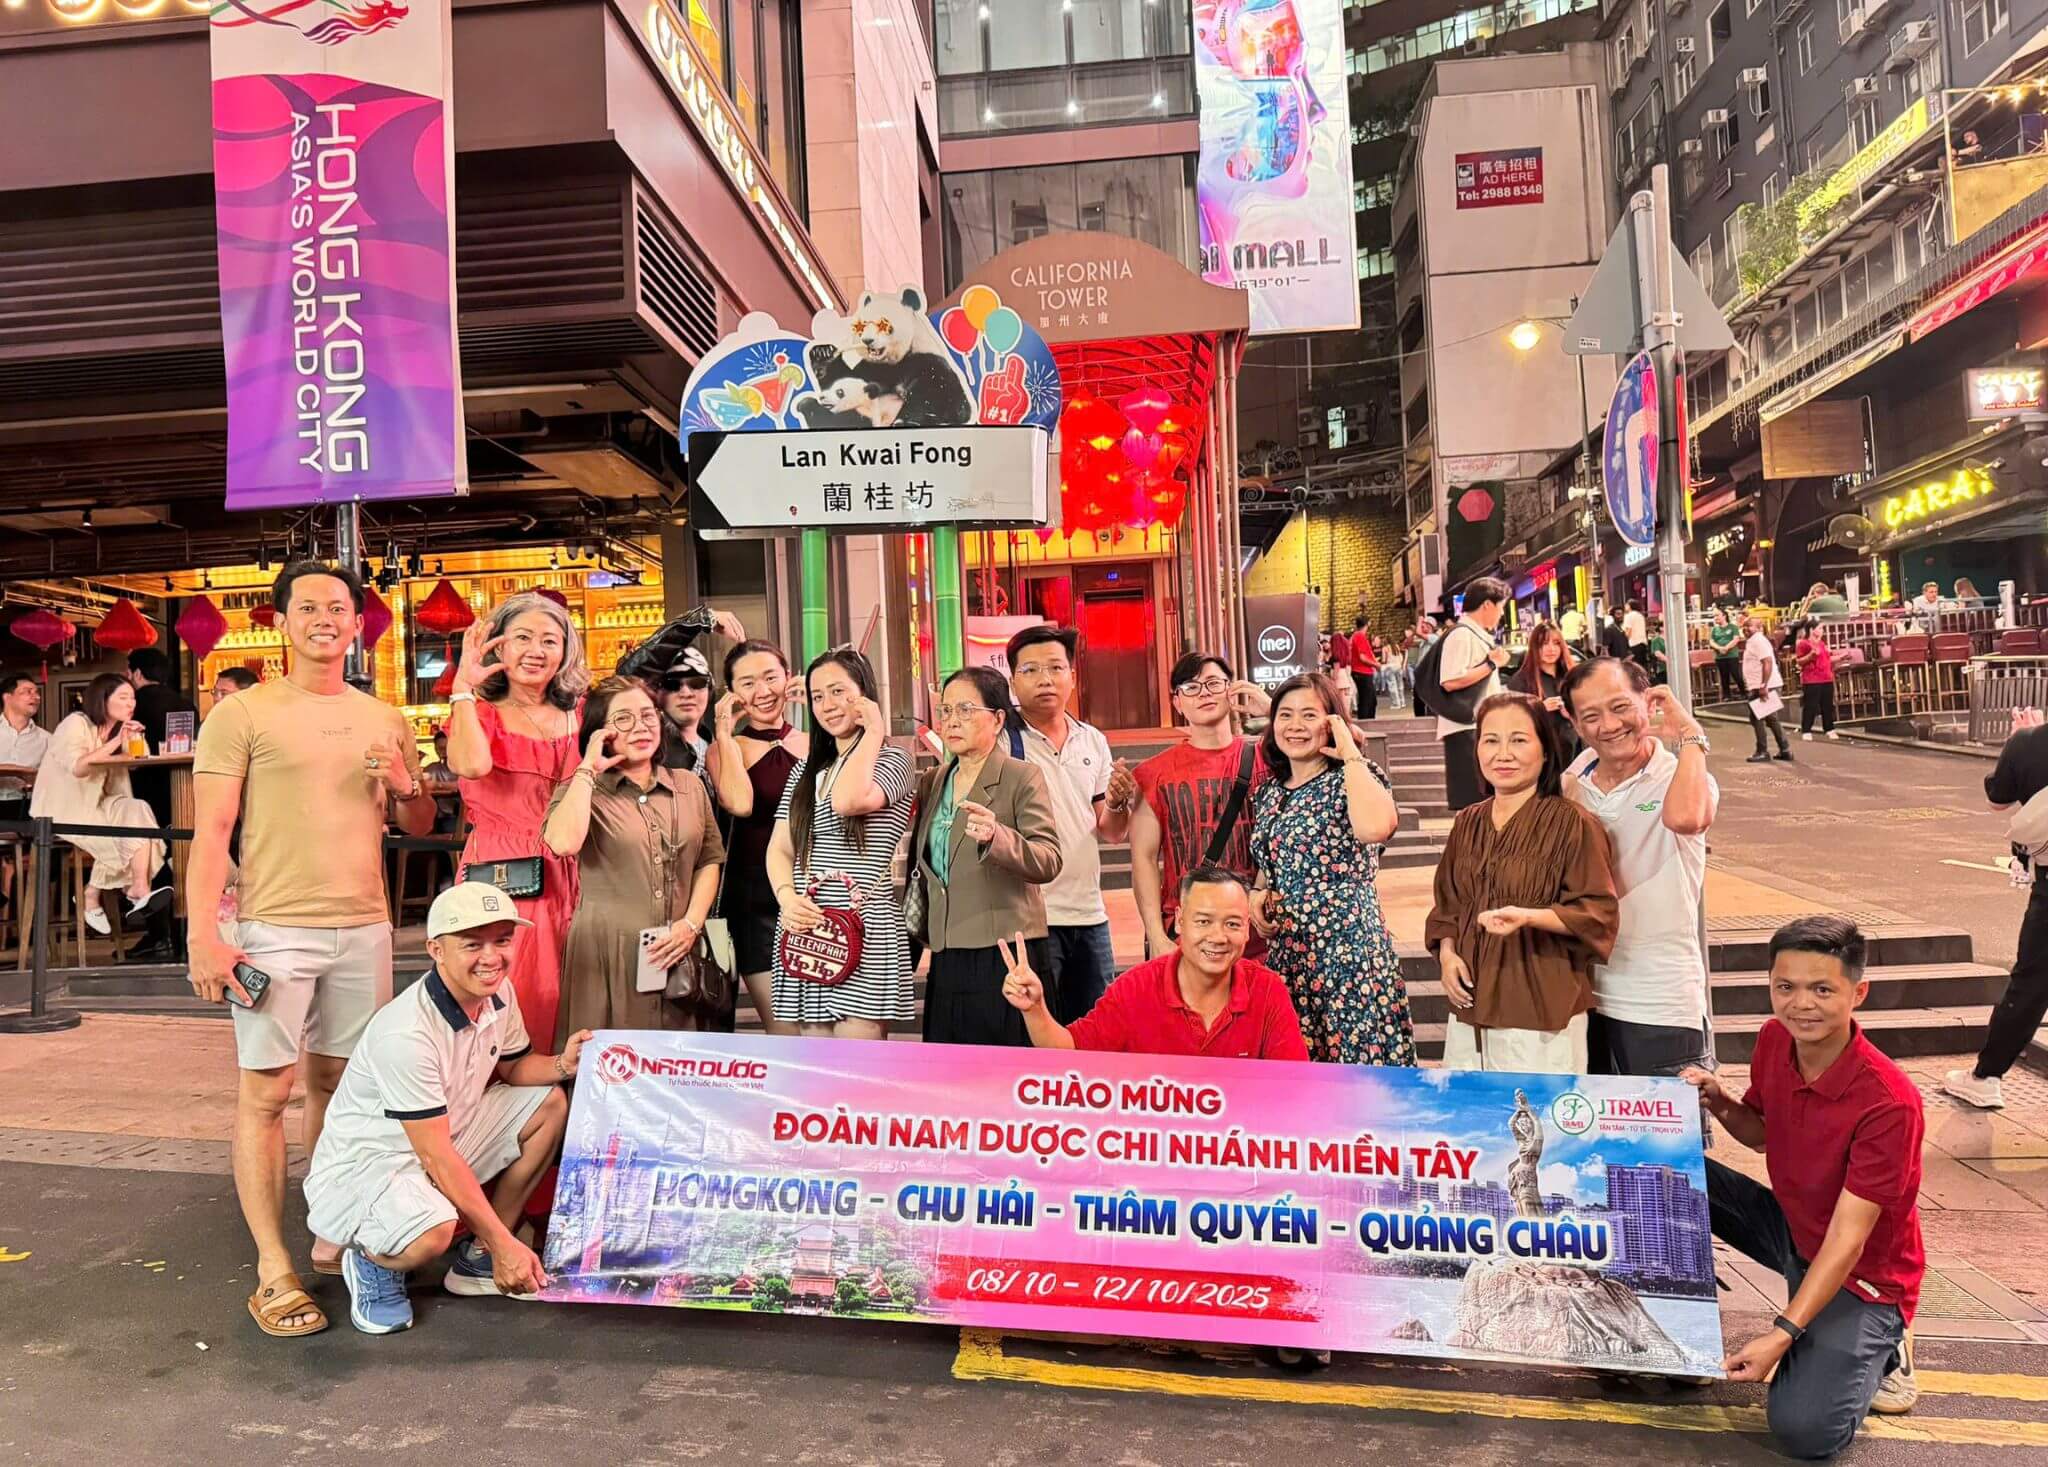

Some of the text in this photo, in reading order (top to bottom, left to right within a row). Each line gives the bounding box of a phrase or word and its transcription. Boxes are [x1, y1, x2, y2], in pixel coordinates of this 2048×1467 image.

[1479, 157, 1537, 175] 廣告招租
[1482, 171, 1535, 185] AD HERE
[1458, 183, 1543, 201] Tel: 2988 8348
[1010, 258, 1134, 288] CALIFORNIA
[291, 111, 324, 473] ASIA'S WORLD CITY
[315, 103, 369, 472] HONG KONG
[1037, 286, 1109, 311] TOWER
[781, 441, 972, 468] Lan Kwai Fong
[822, 480, 935, 513] 蘭桂坊
[786, 934, 849, 960] HELENPHAM
[640, 1057, 696, 1077] NAM
[1018, 1075, 1222, 1115] CHÀO MỪNG
[773, 1107, 1479, 1180] ĐOÀN NAM DƯỢC CHI NHÁNH MIỀN TÂY
[653, 1171, 858, 1216] HONGKONG
[897, 1184, 966, 1223] CHU
[976, 1179, 1034, 1227] HẢI
[1074, 1190, 1177, 1236] THÂM
[1189, 1194, 1317, 1245] QUYẾN
[1360, 1204, 1494, 1255] QUẢNG
[1507, 1215, 1607, 1261] CHÂU
